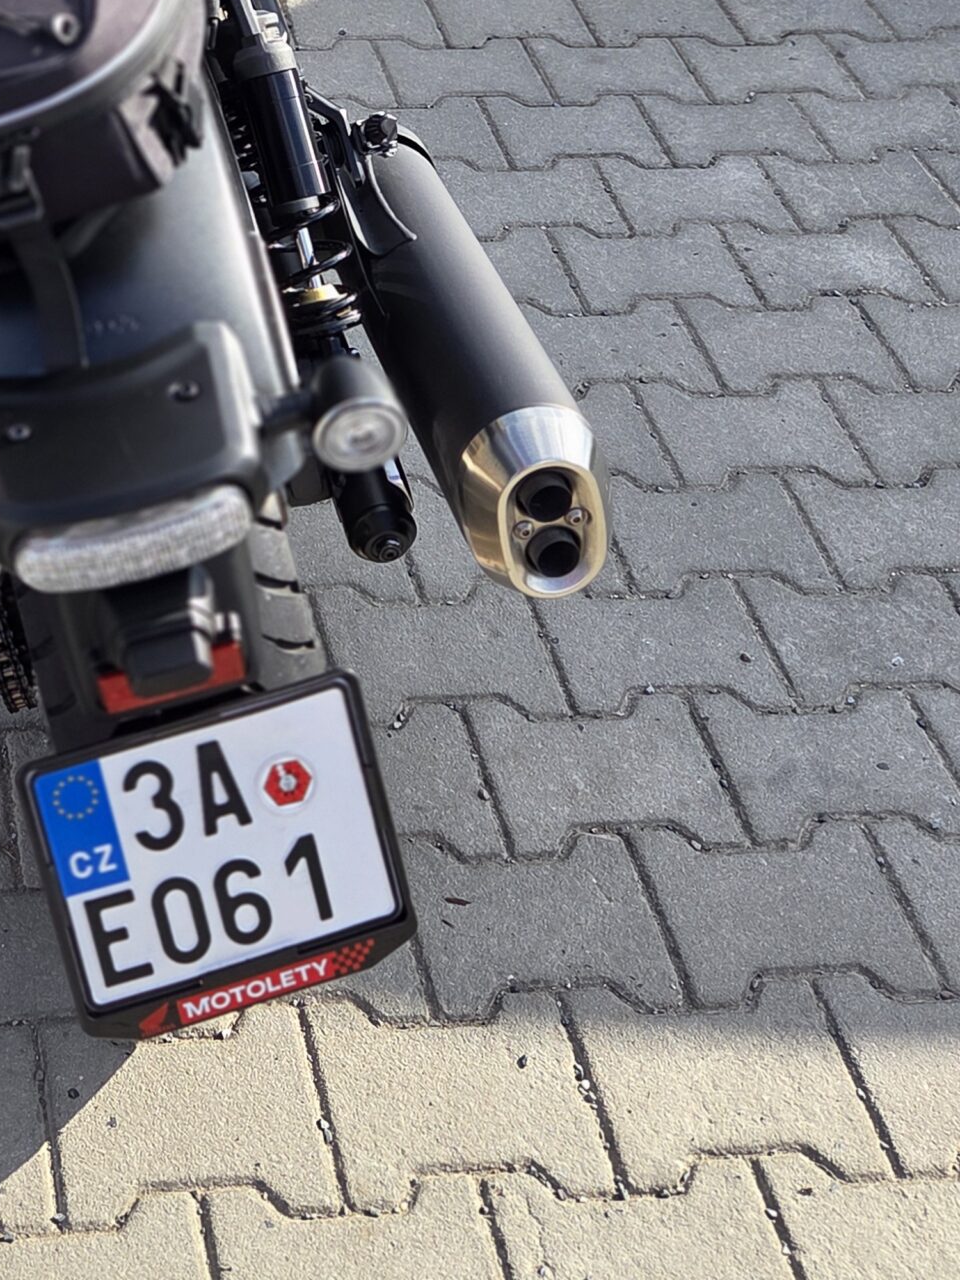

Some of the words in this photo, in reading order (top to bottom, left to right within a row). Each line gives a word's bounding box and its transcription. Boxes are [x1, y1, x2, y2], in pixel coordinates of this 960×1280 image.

[122, 740, 253, 851] 3A
[69, 844, 118, 879] CZ
[84, 833, 334, 988] E061
[182, 958, 329, 1019] MOTOLETY
